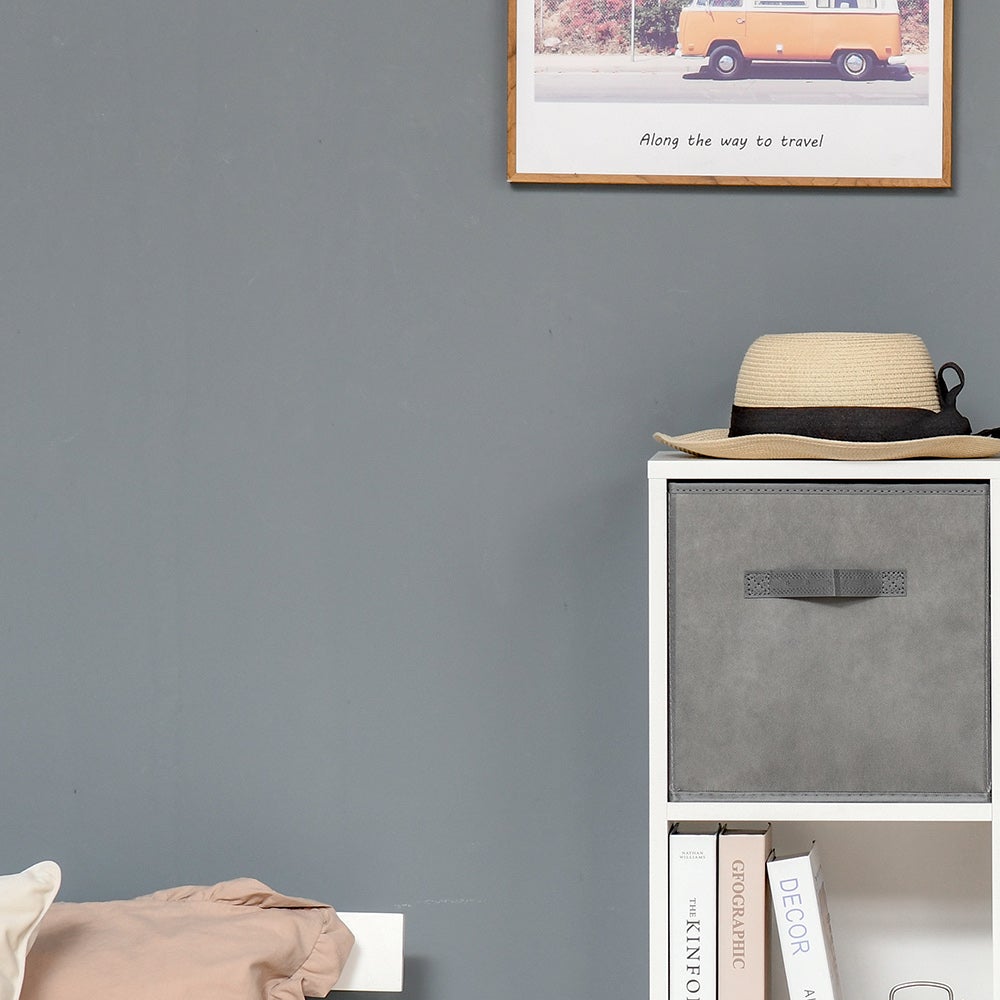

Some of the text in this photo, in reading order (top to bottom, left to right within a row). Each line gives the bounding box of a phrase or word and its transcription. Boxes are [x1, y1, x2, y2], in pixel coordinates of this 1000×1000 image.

[639, 133, 824, 150] Along the way to travel
[689, 898, 697, 917] THE
[779, 877, 811, 956] DECOR
